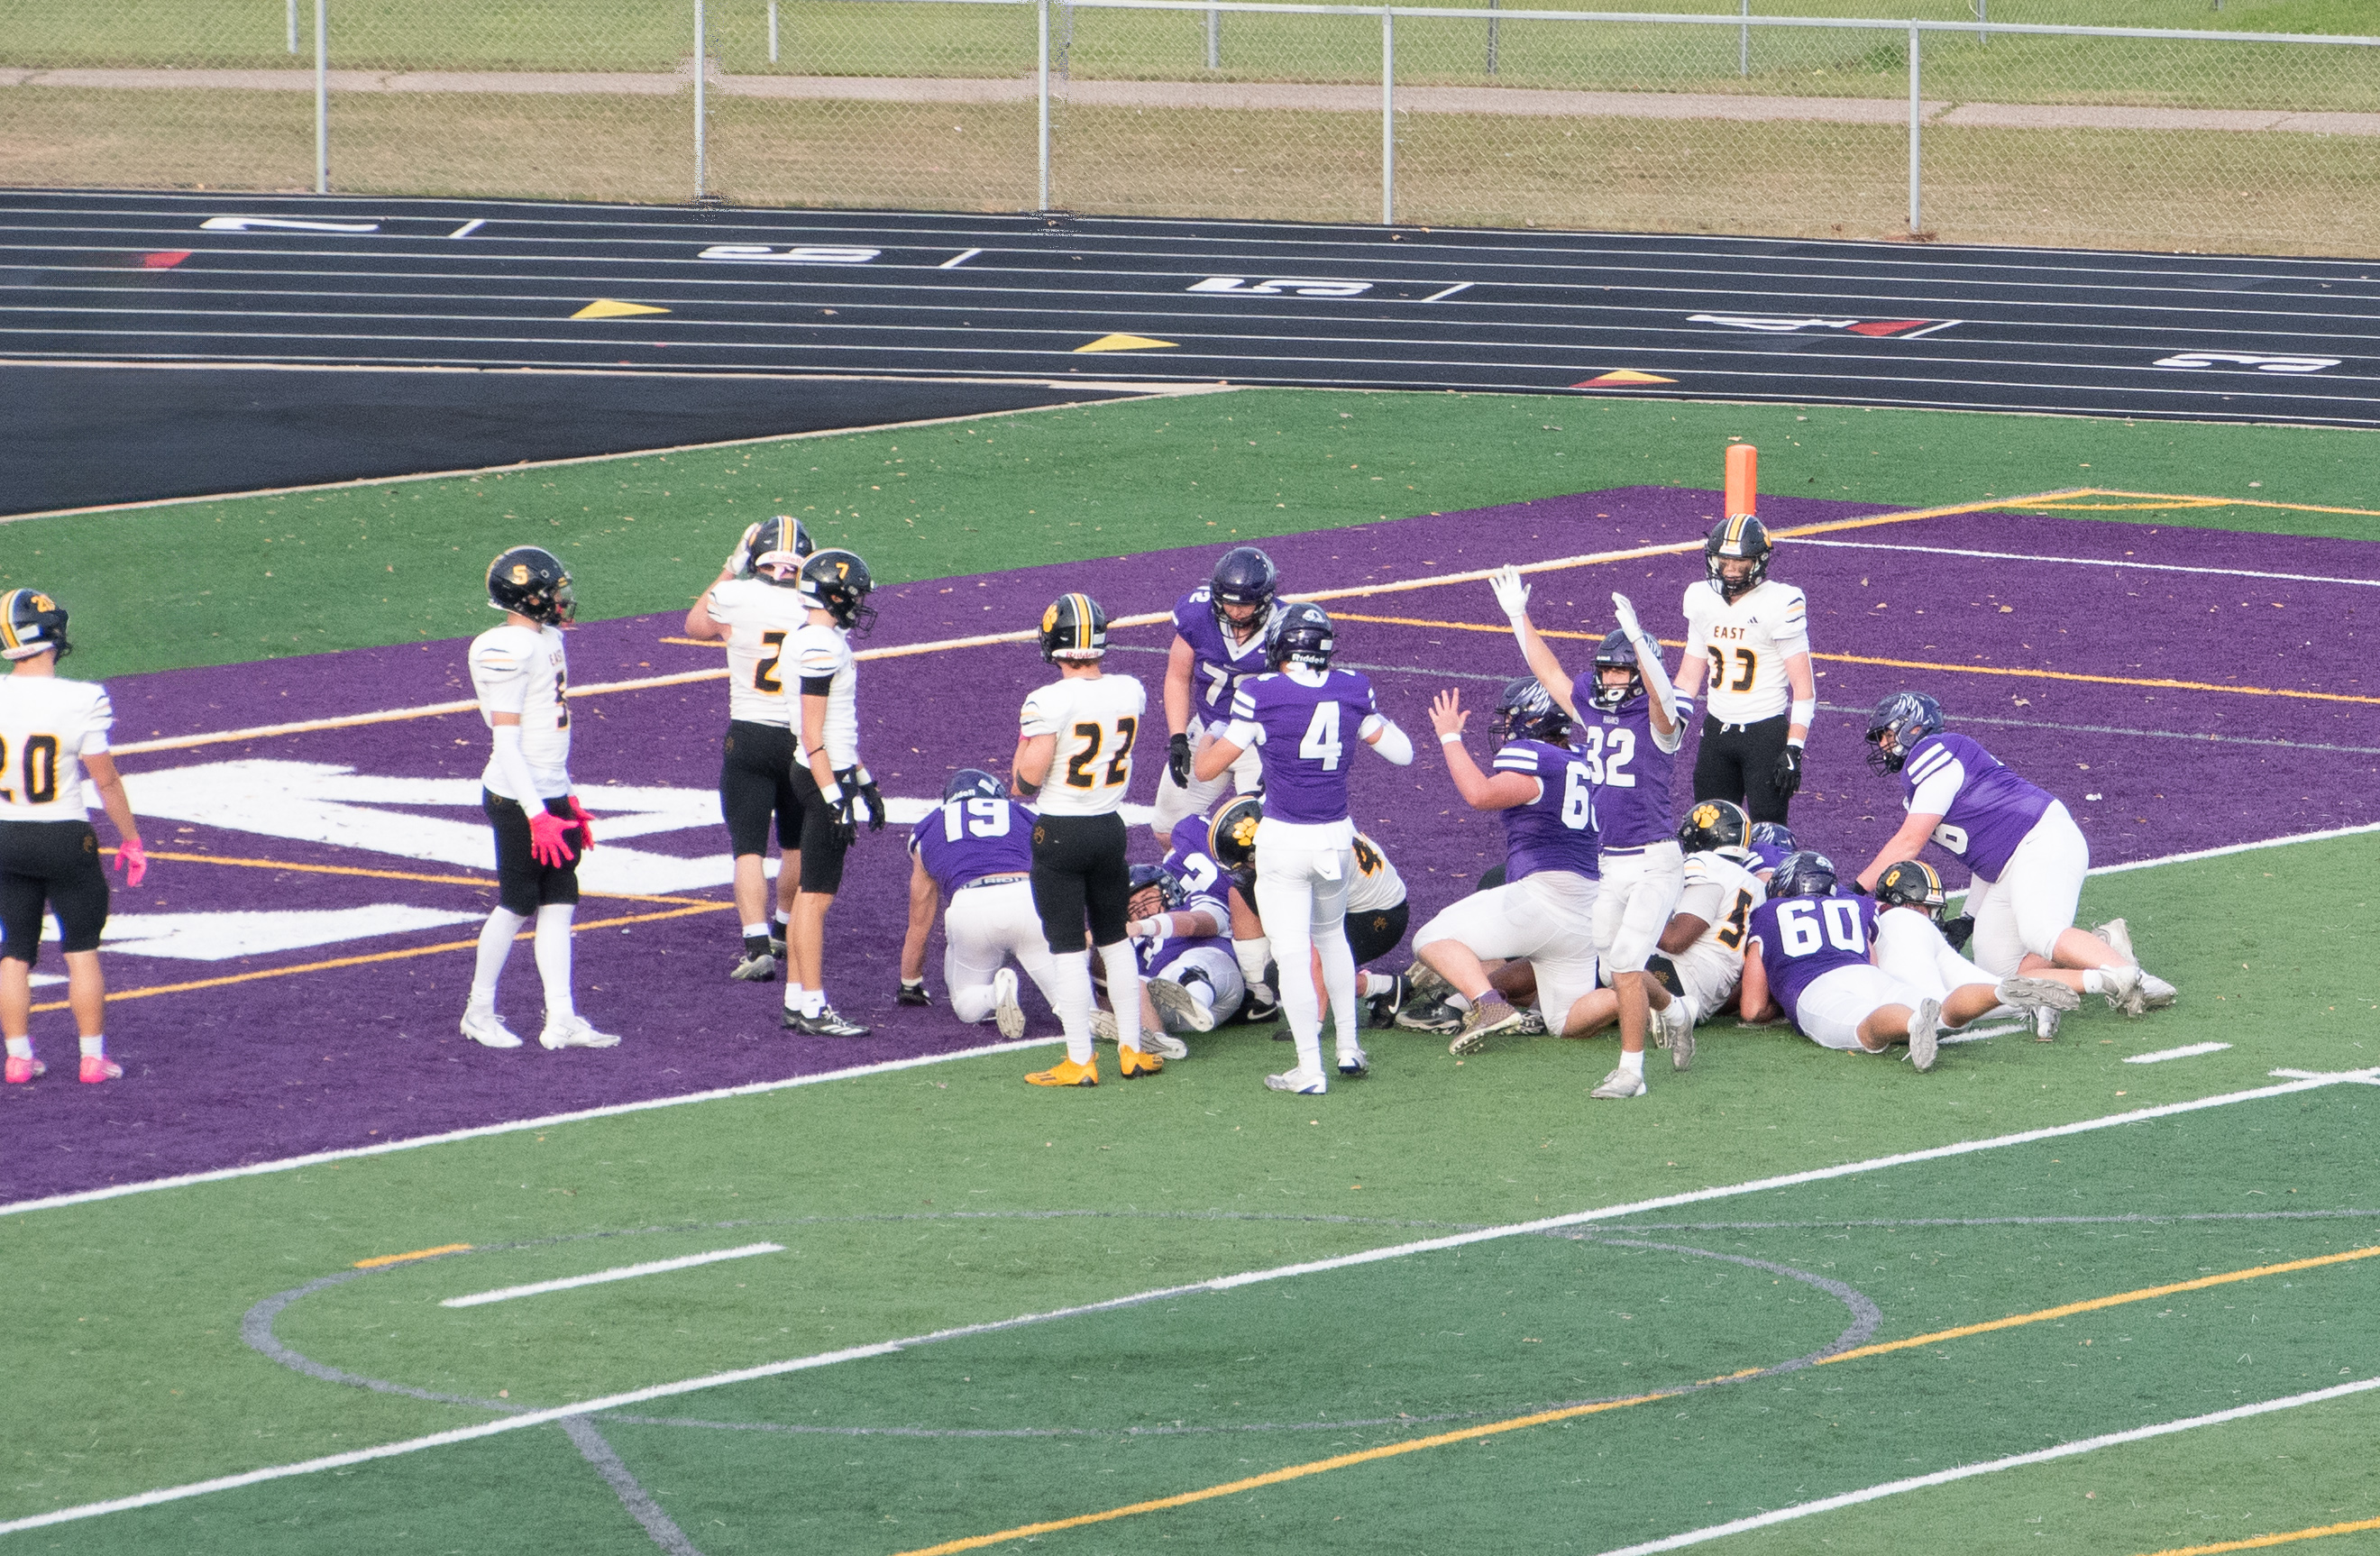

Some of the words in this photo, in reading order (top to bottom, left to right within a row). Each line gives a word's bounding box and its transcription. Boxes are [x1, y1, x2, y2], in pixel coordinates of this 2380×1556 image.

[512, 564, 528, 585] 5
[836, 563, 849, 580] 7
[1713, 626, 1745, 640] EAST
[1066, 651, 1099, 659] Riddell
[1291, 653, 1326, 664] Riddell
[1707, 644, 1759, 693] 33
[1299, 700, 1342, 771] 4
[1066, 716, 1137, 791] 22
[1587, 726, 1636, 787] 32
[940, 798, 1010, 843] 19
[1885, 870, 1901, 888] 8
[1776, 899, 1865, 958] 60
